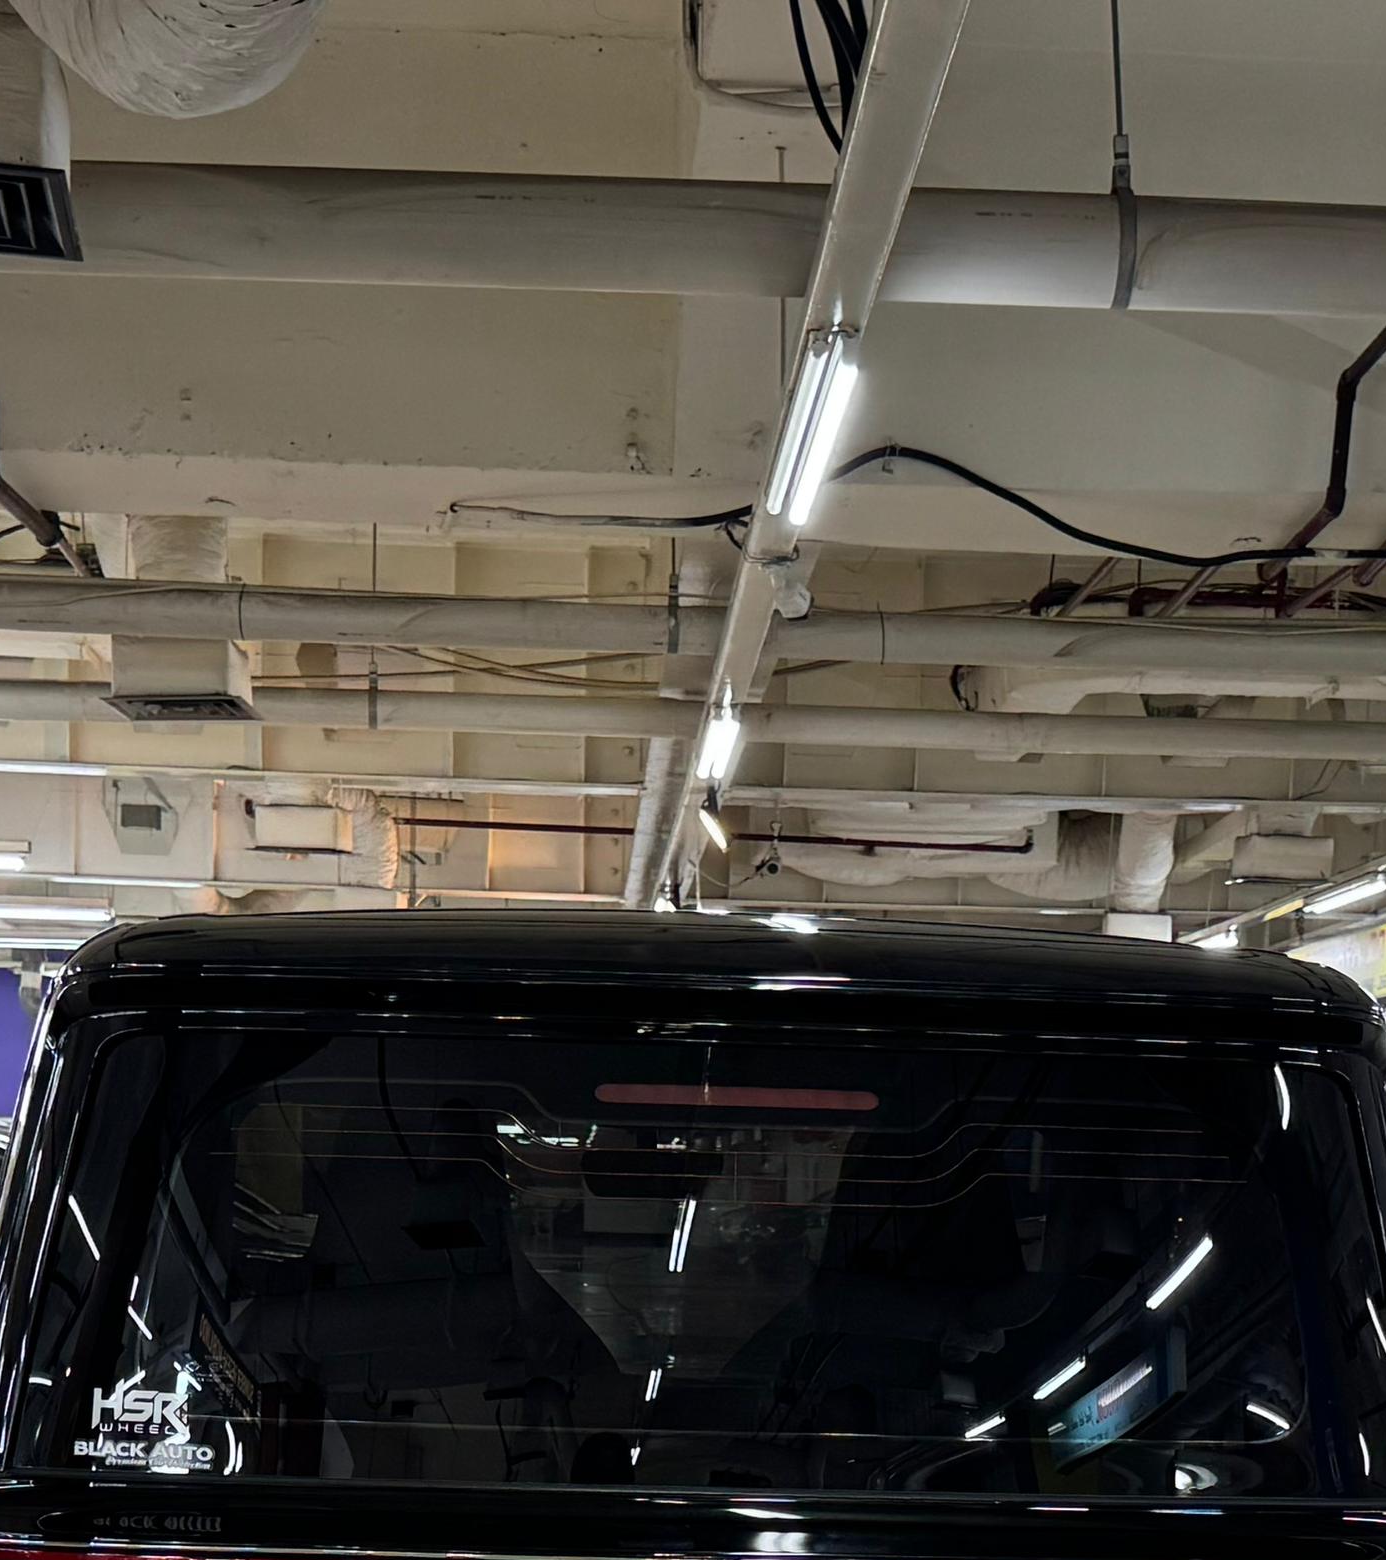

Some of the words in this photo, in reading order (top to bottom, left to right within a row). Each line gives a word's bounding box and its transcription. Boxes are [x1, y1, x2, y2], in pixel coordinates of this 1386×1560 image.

[91, 1378, 190, 1430] HSR
[73, 1440, 148, 1458] BLACK
[150, 1443, 215, 1462] AUTO
